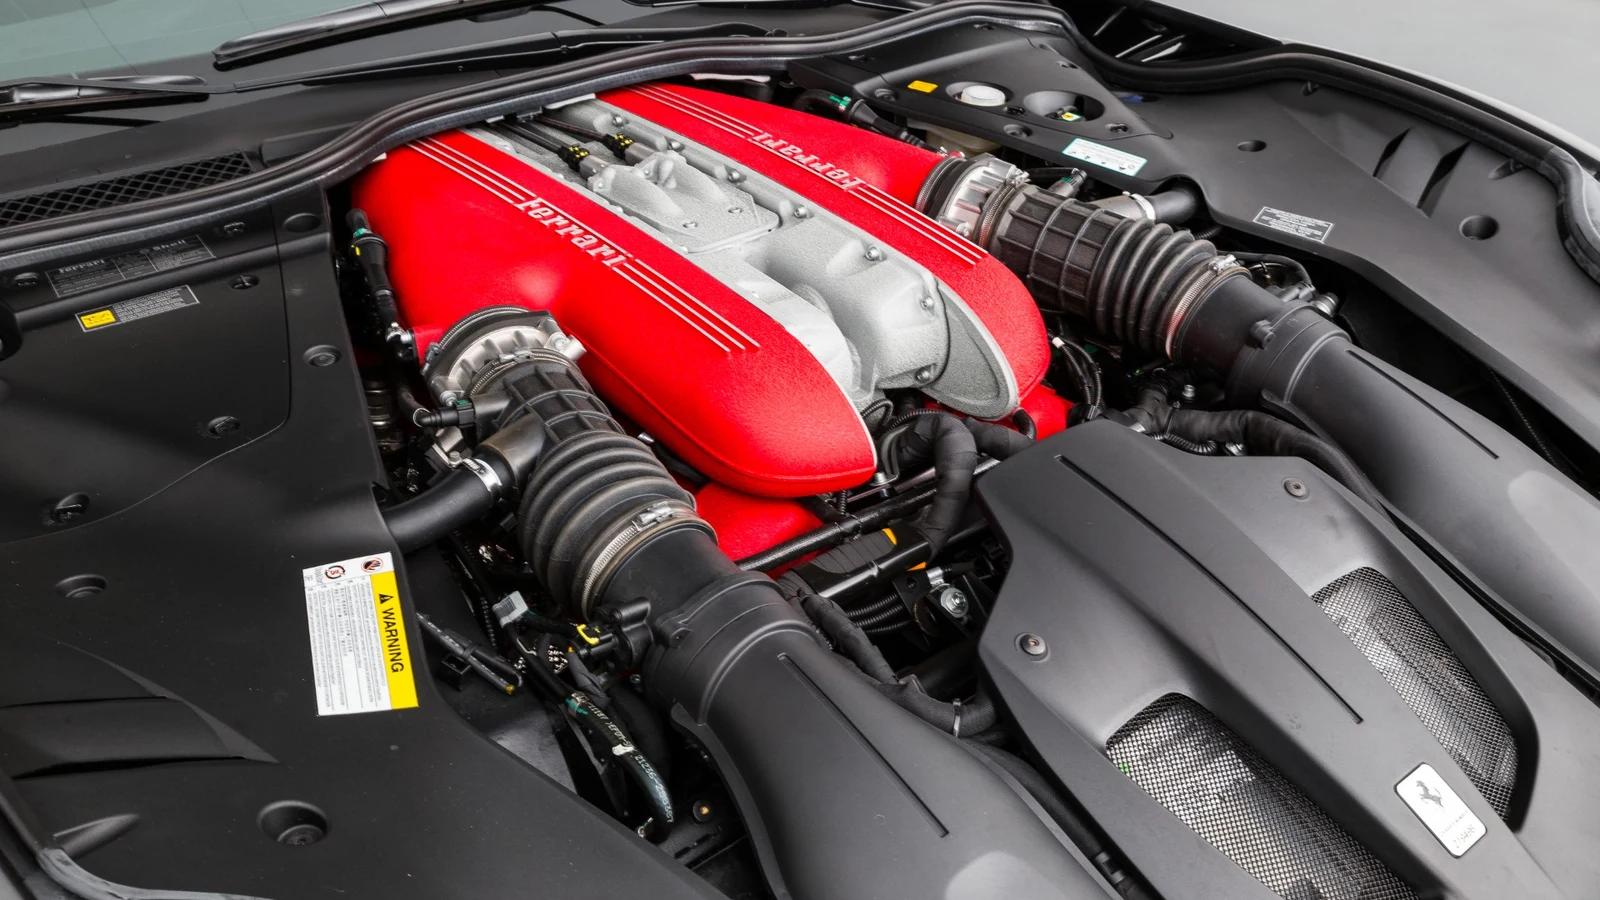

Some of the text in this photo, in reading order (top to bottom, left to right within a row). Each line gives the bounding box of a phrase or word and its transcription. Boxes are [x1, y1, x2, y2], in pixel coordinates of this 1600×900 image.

[748, 132, 866, 191] Ferrari
[151, 239, 187, 252] Shell
[513, 197, 632, 267] Ferrari
[58, 258, 106, 274] Ferrari
[381, 607, 405, 674] WARNING
